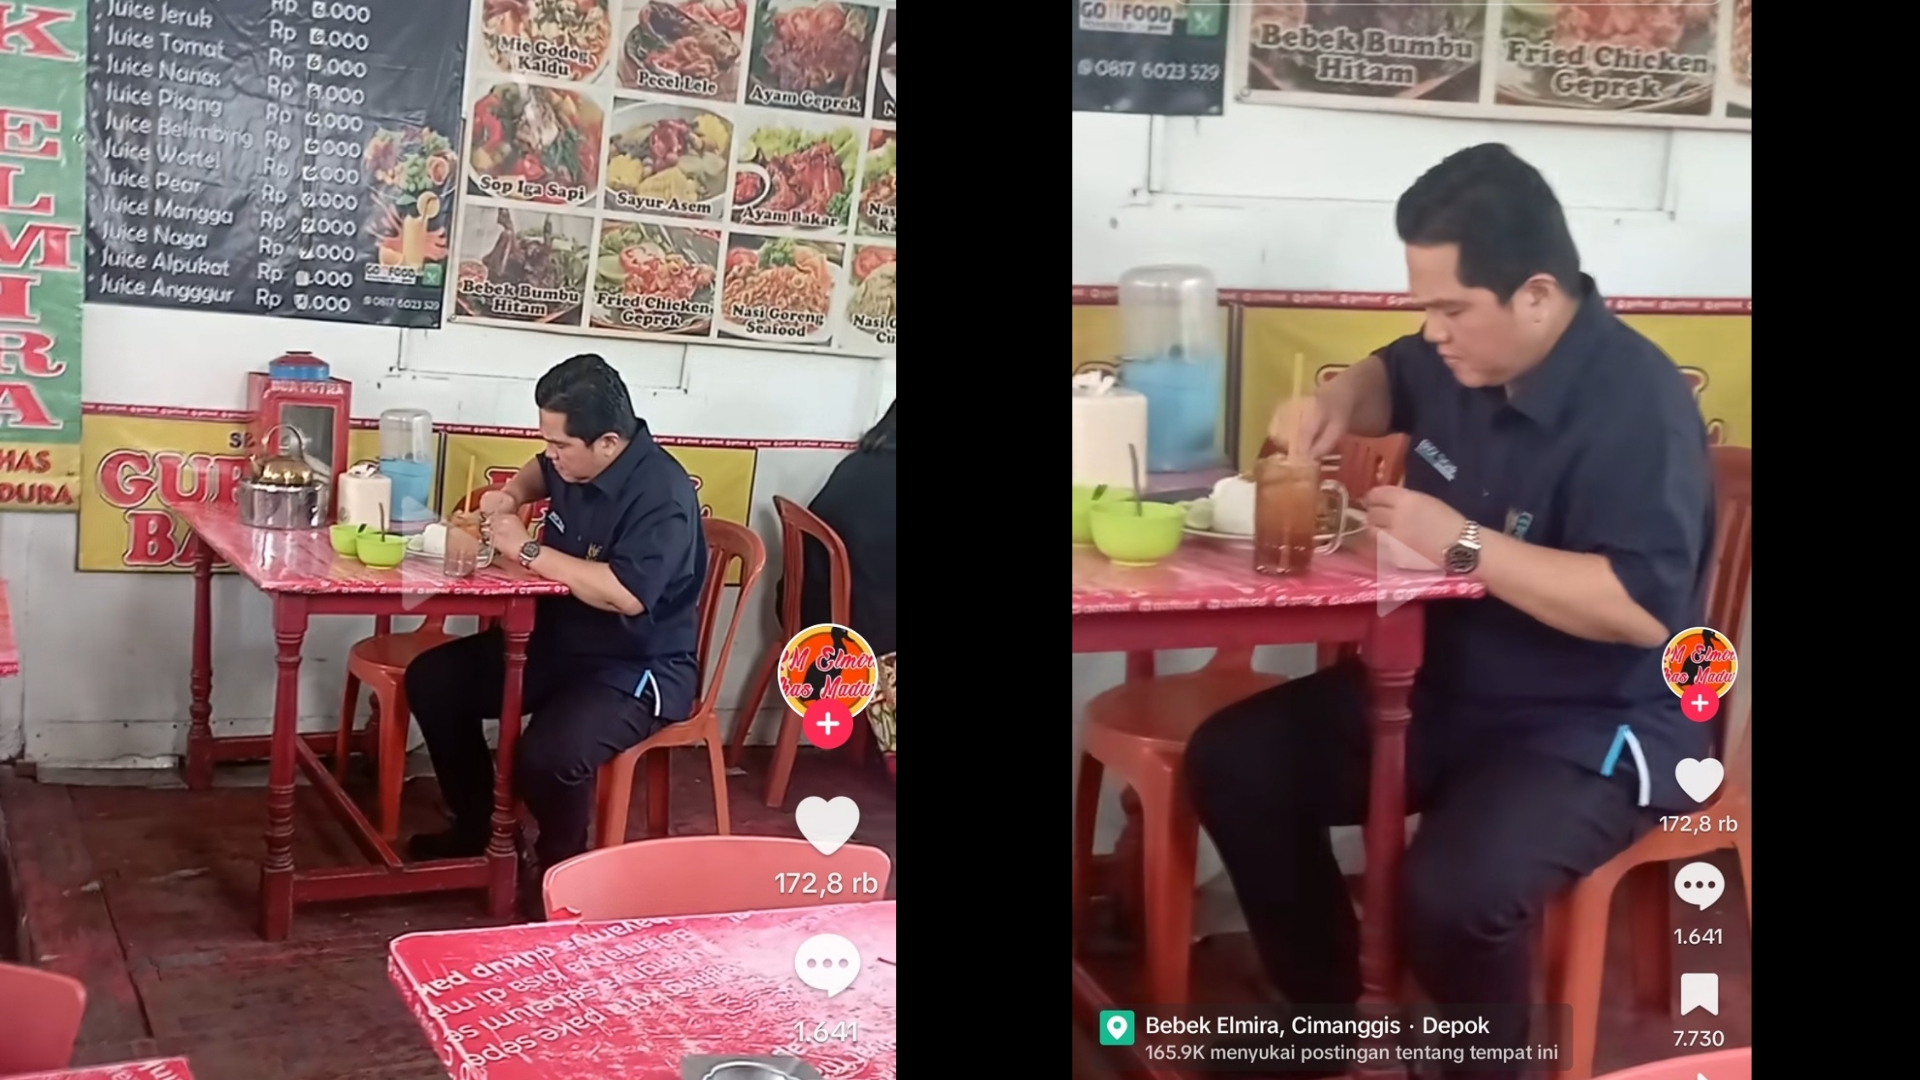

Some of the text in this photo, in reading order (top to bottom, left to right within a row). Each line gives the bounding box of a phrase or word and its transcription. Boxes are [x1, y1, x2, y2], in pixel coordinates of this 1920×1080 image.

[160, 2, 213, 29] Jeruk
[270, 19, 297, 44] Rp
[1122, 4, 1172, 22] FOOD
[107, 24, 154, 49] Juice
[160, 32, 226, 59] Tomat
[269, 47, 295, 71] Rp
[499, 36, 589, 64] Mie Godog
[1260, 23, 1474, 58] Bebek Bumbu
[518, 56, 569, 77] Kaldu
[1317, 56, 1415, 84] Hitam
[1506, 39, 1708, 73] Fried Chicken
[106, 53, 153, 78] Juice
[158, 60, 221, 87] Nanas
[267, 75, 293, 100] Rp
[638, 71, 717, 94] Pecel Lele
[1094, 60, 1220, 81] 0817 6023 529
[752, 85, 860, 112] Ayam Geprek
[1555, 71, 1659, 100] Geprek
[106, 80, 152, 106] Juice
[158, 89, 223, 118] Pisang
[266, 103, 292, 125] Rp
[105, 108, 152, 134] Juice
[157, 116, 253, 149] Belimbing
[265, 130, 291, 152] Rp
[104, 137, 150, 161] Juice
[156, 143, 221, 170] Wortel
[264, 157, 289, 178] Rp
[104, 166, 149, 189] Juice
[155, 172, 201, 193] Pear
[262, 184, 287, 205] Rp
[480, 176, 585, 202] Sop Iga Sapi
[103, 194, 148, 216] Juice
[154, 197, 233, 226] Mangga
[260, 210, 286, 232] Rp
[617, 192, 711, 215] Sayur Asem
[742, 206, 838, 226] Ayam Bakar
[102, 221, 148, 244] Juice
[153, 224, 208, 250] Naga
[259, 236, 284, 258] Rp
[101, 244, 147, 269] Juice
[151, 251, 230, 277] Alpukat
[257, 262, 283, 284] Rp
[100, 272, 146, 296] Juice
[255, 288, 282, 309] Rp
[462, 279, 579, 302] Bebek Bumbu
[596, 291, 710, 313] Fried Chicken
[493, 299, 545, 315] Hitam
[622, 310, 681, 327] Geprek
[732, 304, 824, 326] Nasi Goreng
[745, 321, 806, 337] Seafood
[477, 987, 507, 1005] di
